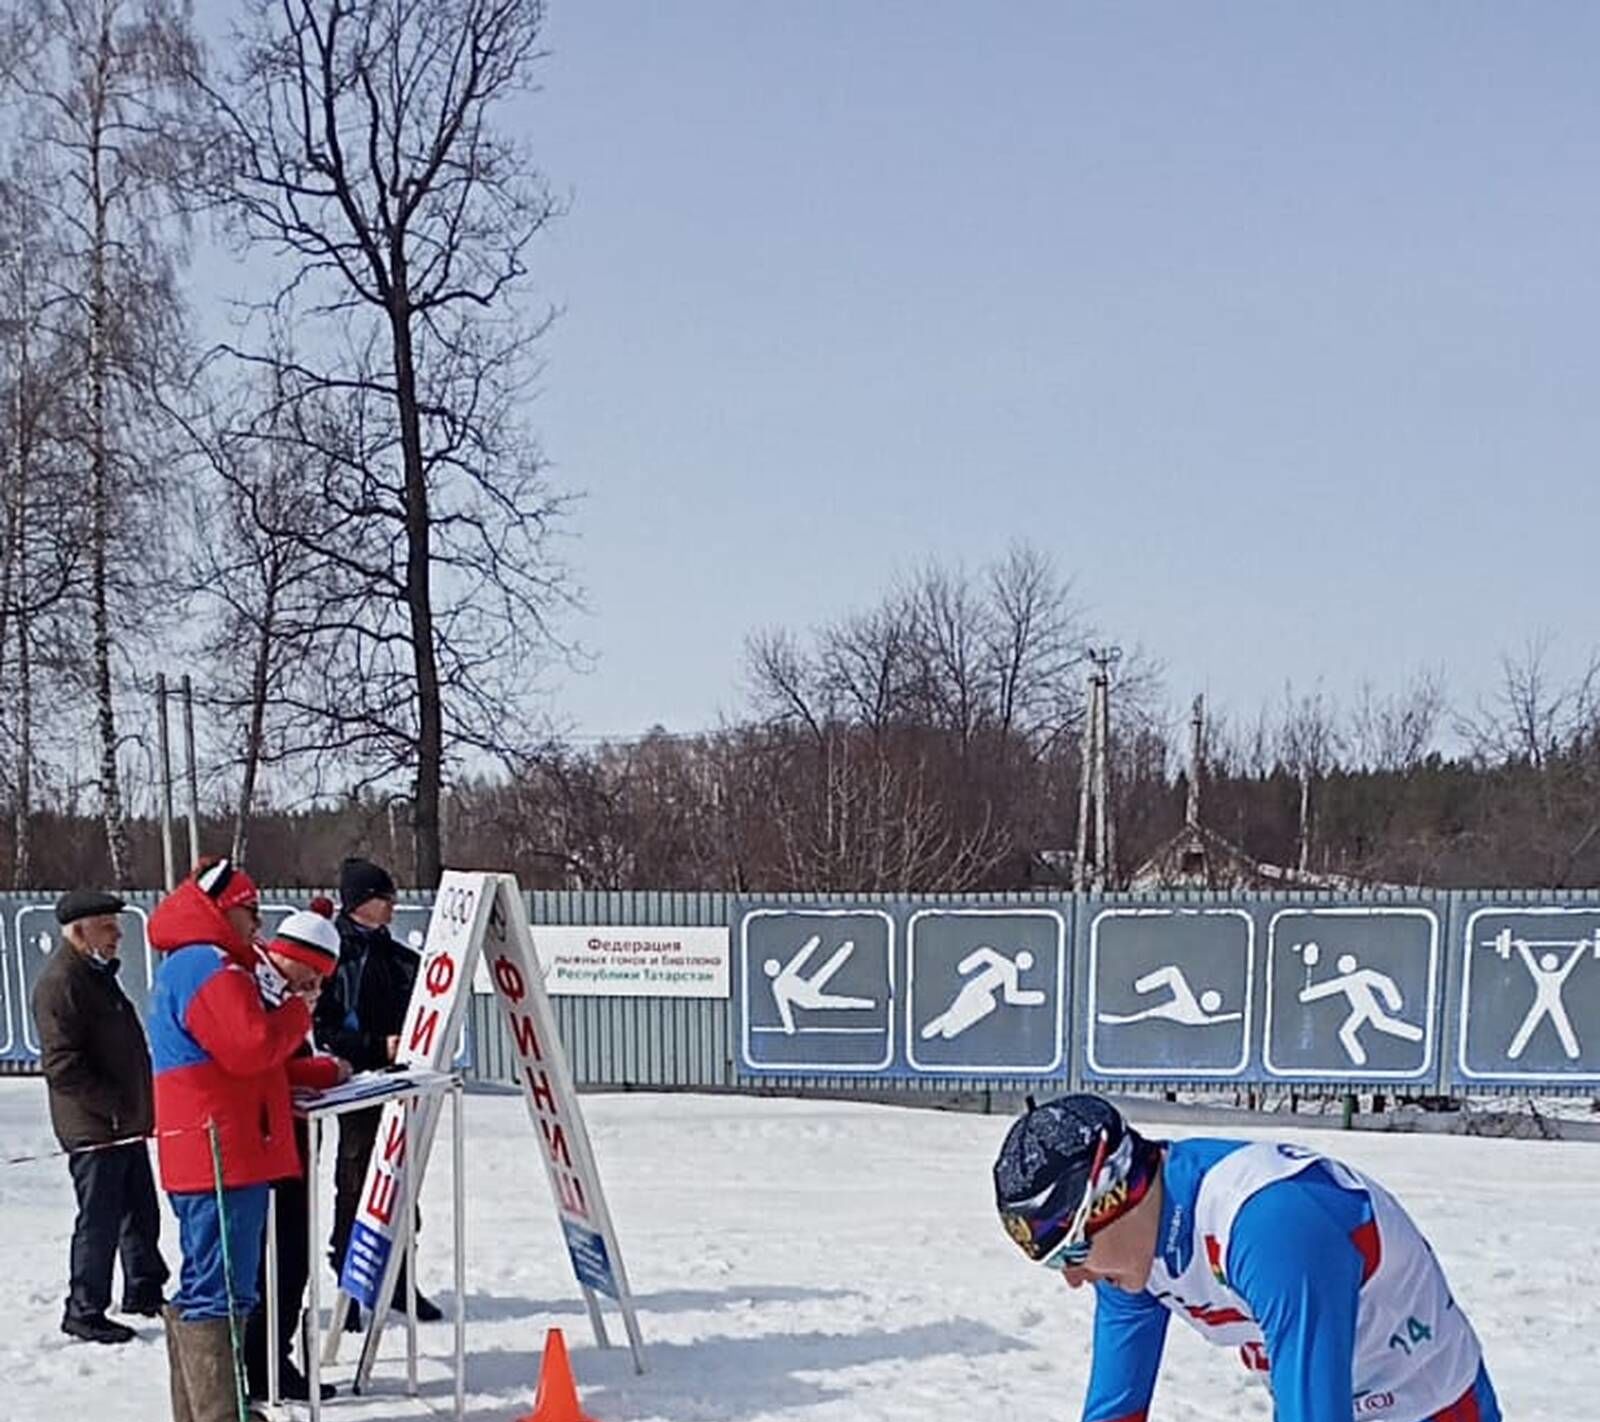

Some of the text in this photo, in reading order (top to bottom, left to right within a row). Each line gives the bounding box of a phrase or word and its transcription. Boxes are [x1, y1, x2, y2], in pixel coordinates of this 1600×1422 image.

[588, 938, 681, 953] Федерация
[557, 969, 713, 982] Республики Татарстан
[367, 952, 455, 1227] ФИИШ
[495, 955, 589, 1219] ФИНИШ
[1389, 1316, 1431, 1356] 14
